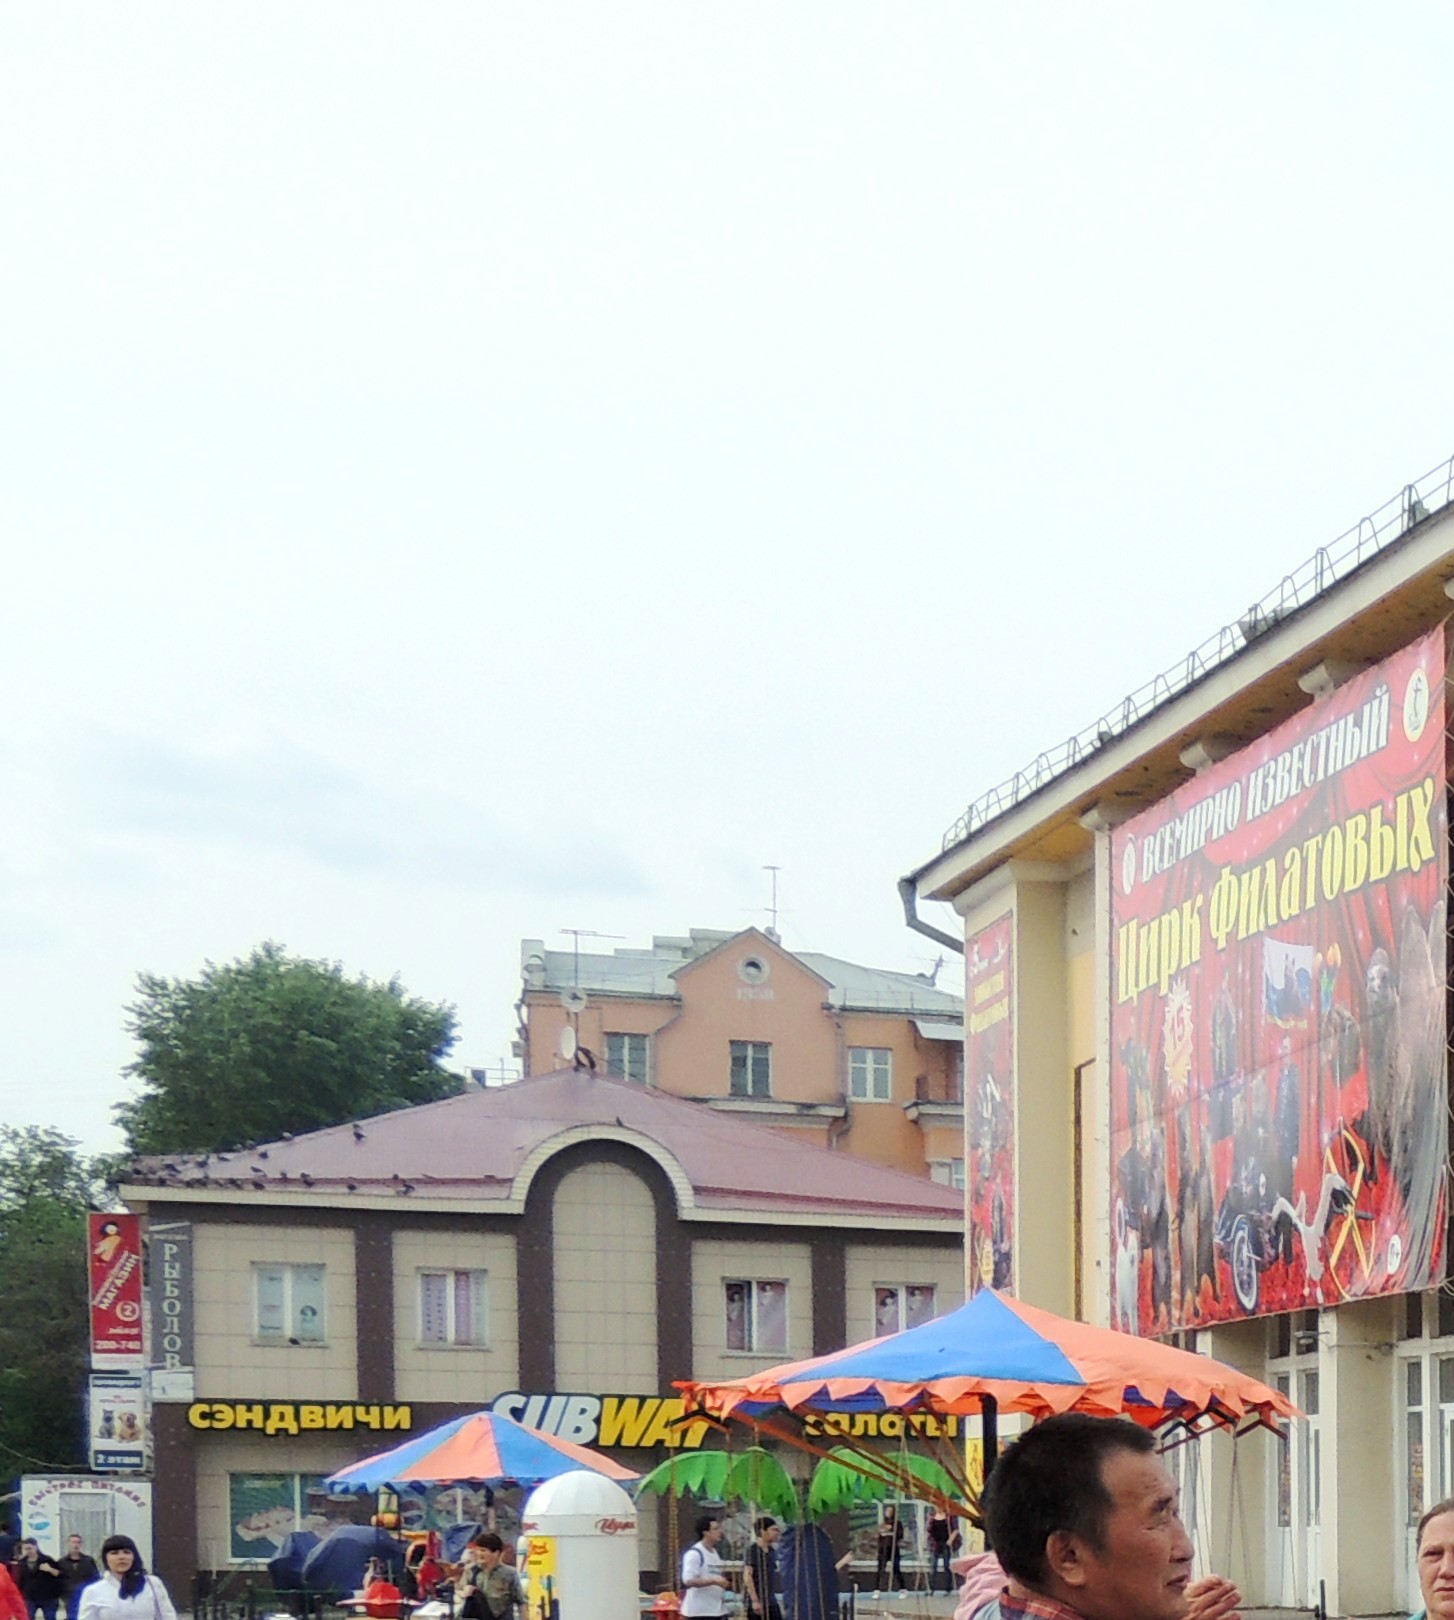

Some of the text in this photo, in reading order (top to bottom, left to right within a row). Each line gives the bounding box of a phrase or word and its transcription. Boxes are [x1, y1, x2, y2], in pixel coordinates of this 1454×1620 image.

[1142, 684, 1390, 883] ВСЕМИРНО ИЗВЕСТНЫЙ
[161, 1243, 182, 1369] РЫБОЛОВ
